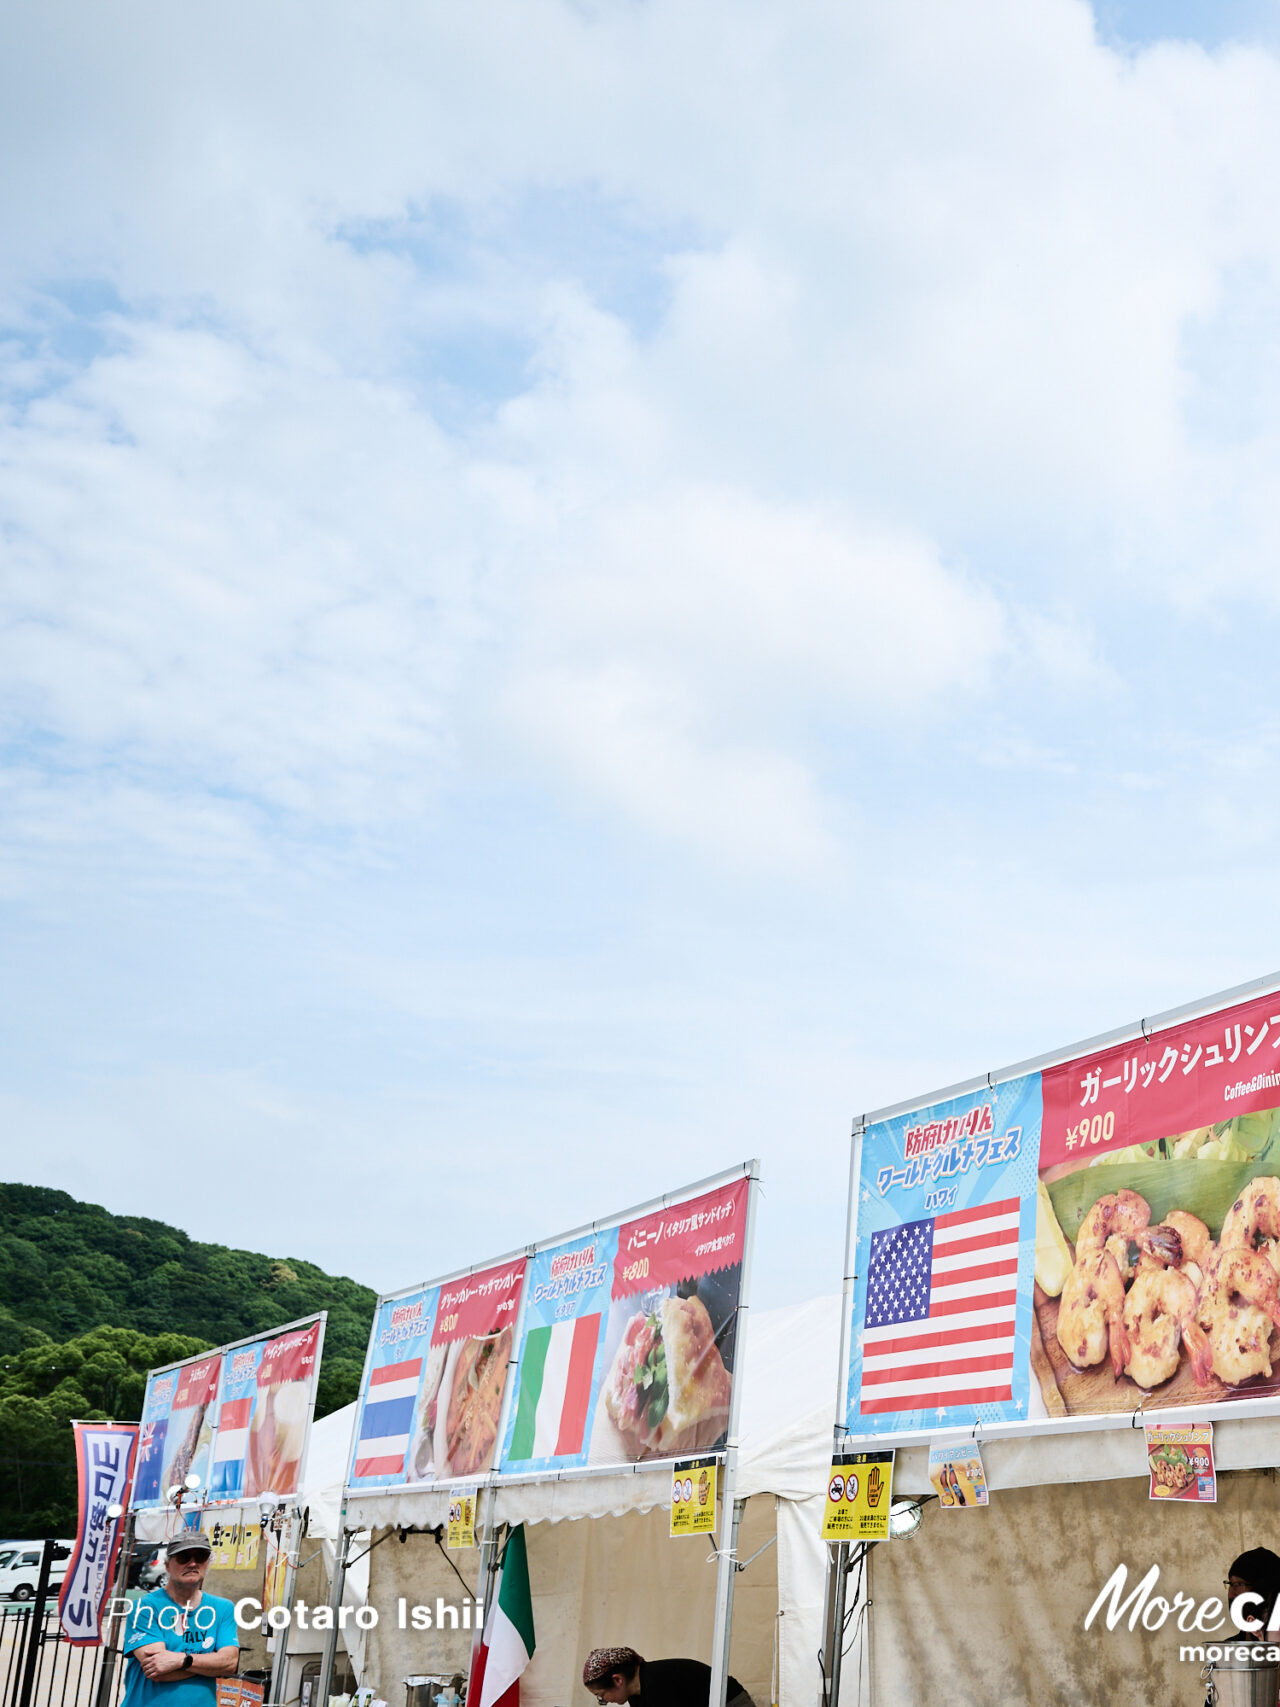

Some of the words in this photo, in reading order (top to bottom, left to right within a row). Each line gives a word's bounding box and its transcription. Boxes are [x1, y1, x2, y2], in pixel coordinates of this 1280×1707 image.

[905, 1106, 992, 1158] 防府けいりん
[1065, 1110, 1115, 1150] ¥900
[925, 1185, 957, 1209] ハワイ
[622, 1257, 650, 1281] ¥800
